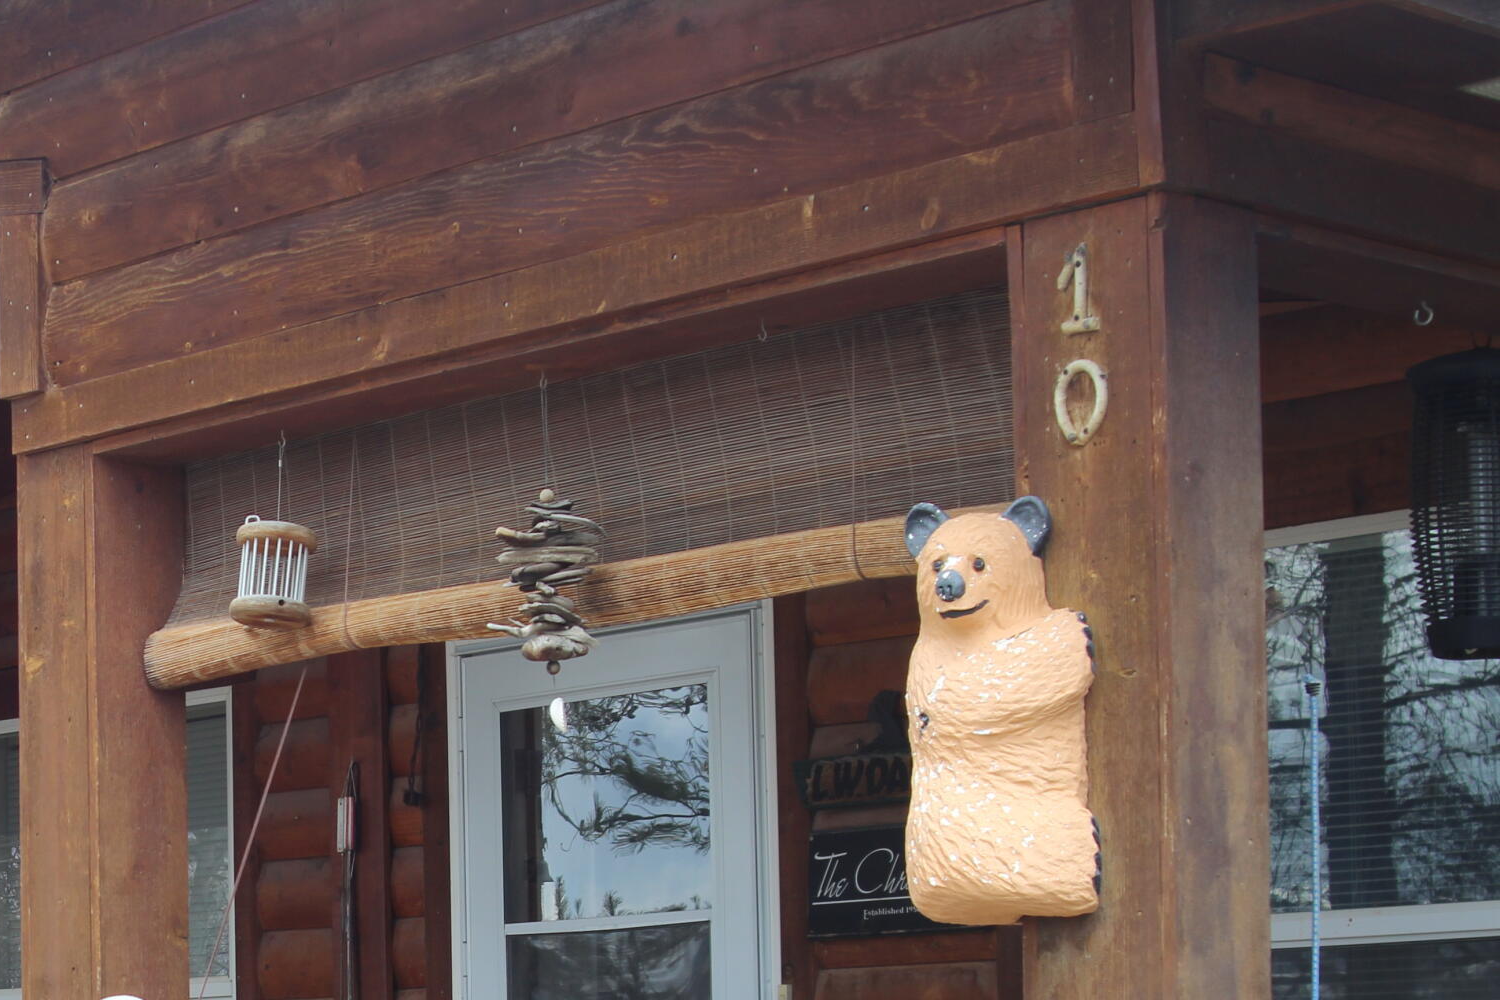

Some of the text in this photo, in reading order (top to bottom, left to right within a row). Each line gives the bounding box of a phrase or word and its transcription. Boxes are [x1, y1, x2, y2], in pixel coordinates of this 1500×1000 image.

[1053, 242, 1109, 446] 10
[814, 848, 909, 898] The Chr
[863, 906, 904, 920] Established
